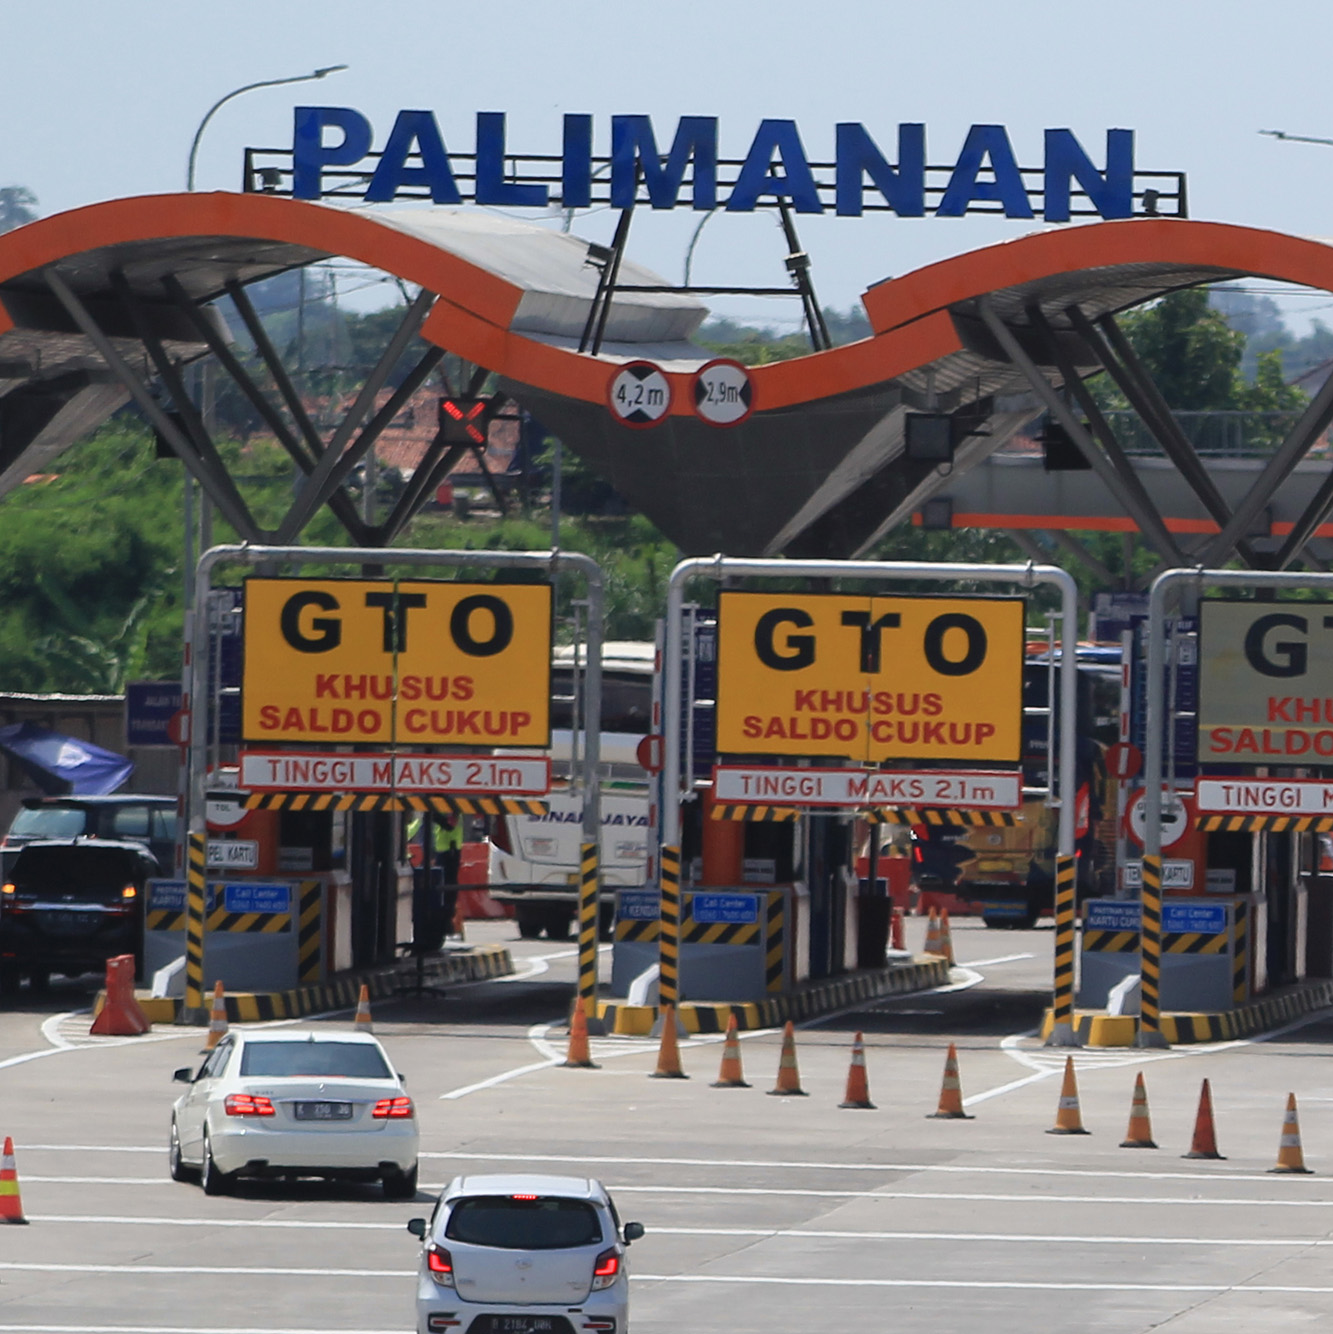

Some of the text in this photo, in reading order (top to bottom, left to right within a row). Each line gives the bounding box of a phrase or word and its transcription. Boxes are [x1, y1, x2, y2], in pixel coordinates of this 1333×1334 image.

[292, 106, 1134, 222] PALIMANAN
[280, 591, 514, 658] GTO
[754, 608, 988, 677] GTO
[316, 674, 474, 701] KHUSUS
[794, 690, 943, 716] KHUSUS
[259, 705, 532, 736] SALDO CUKUP
[742, 716, 996, 746] SALDO CUKUP
[267, 759, 355, 783] TINGGI
[373, 761, 452, 786] MAKS
[740, 776, 822, 796] TINGGI
[848, 778, 924, 798] MAKS
[1221, 786, 1302, 808] TINGGI
